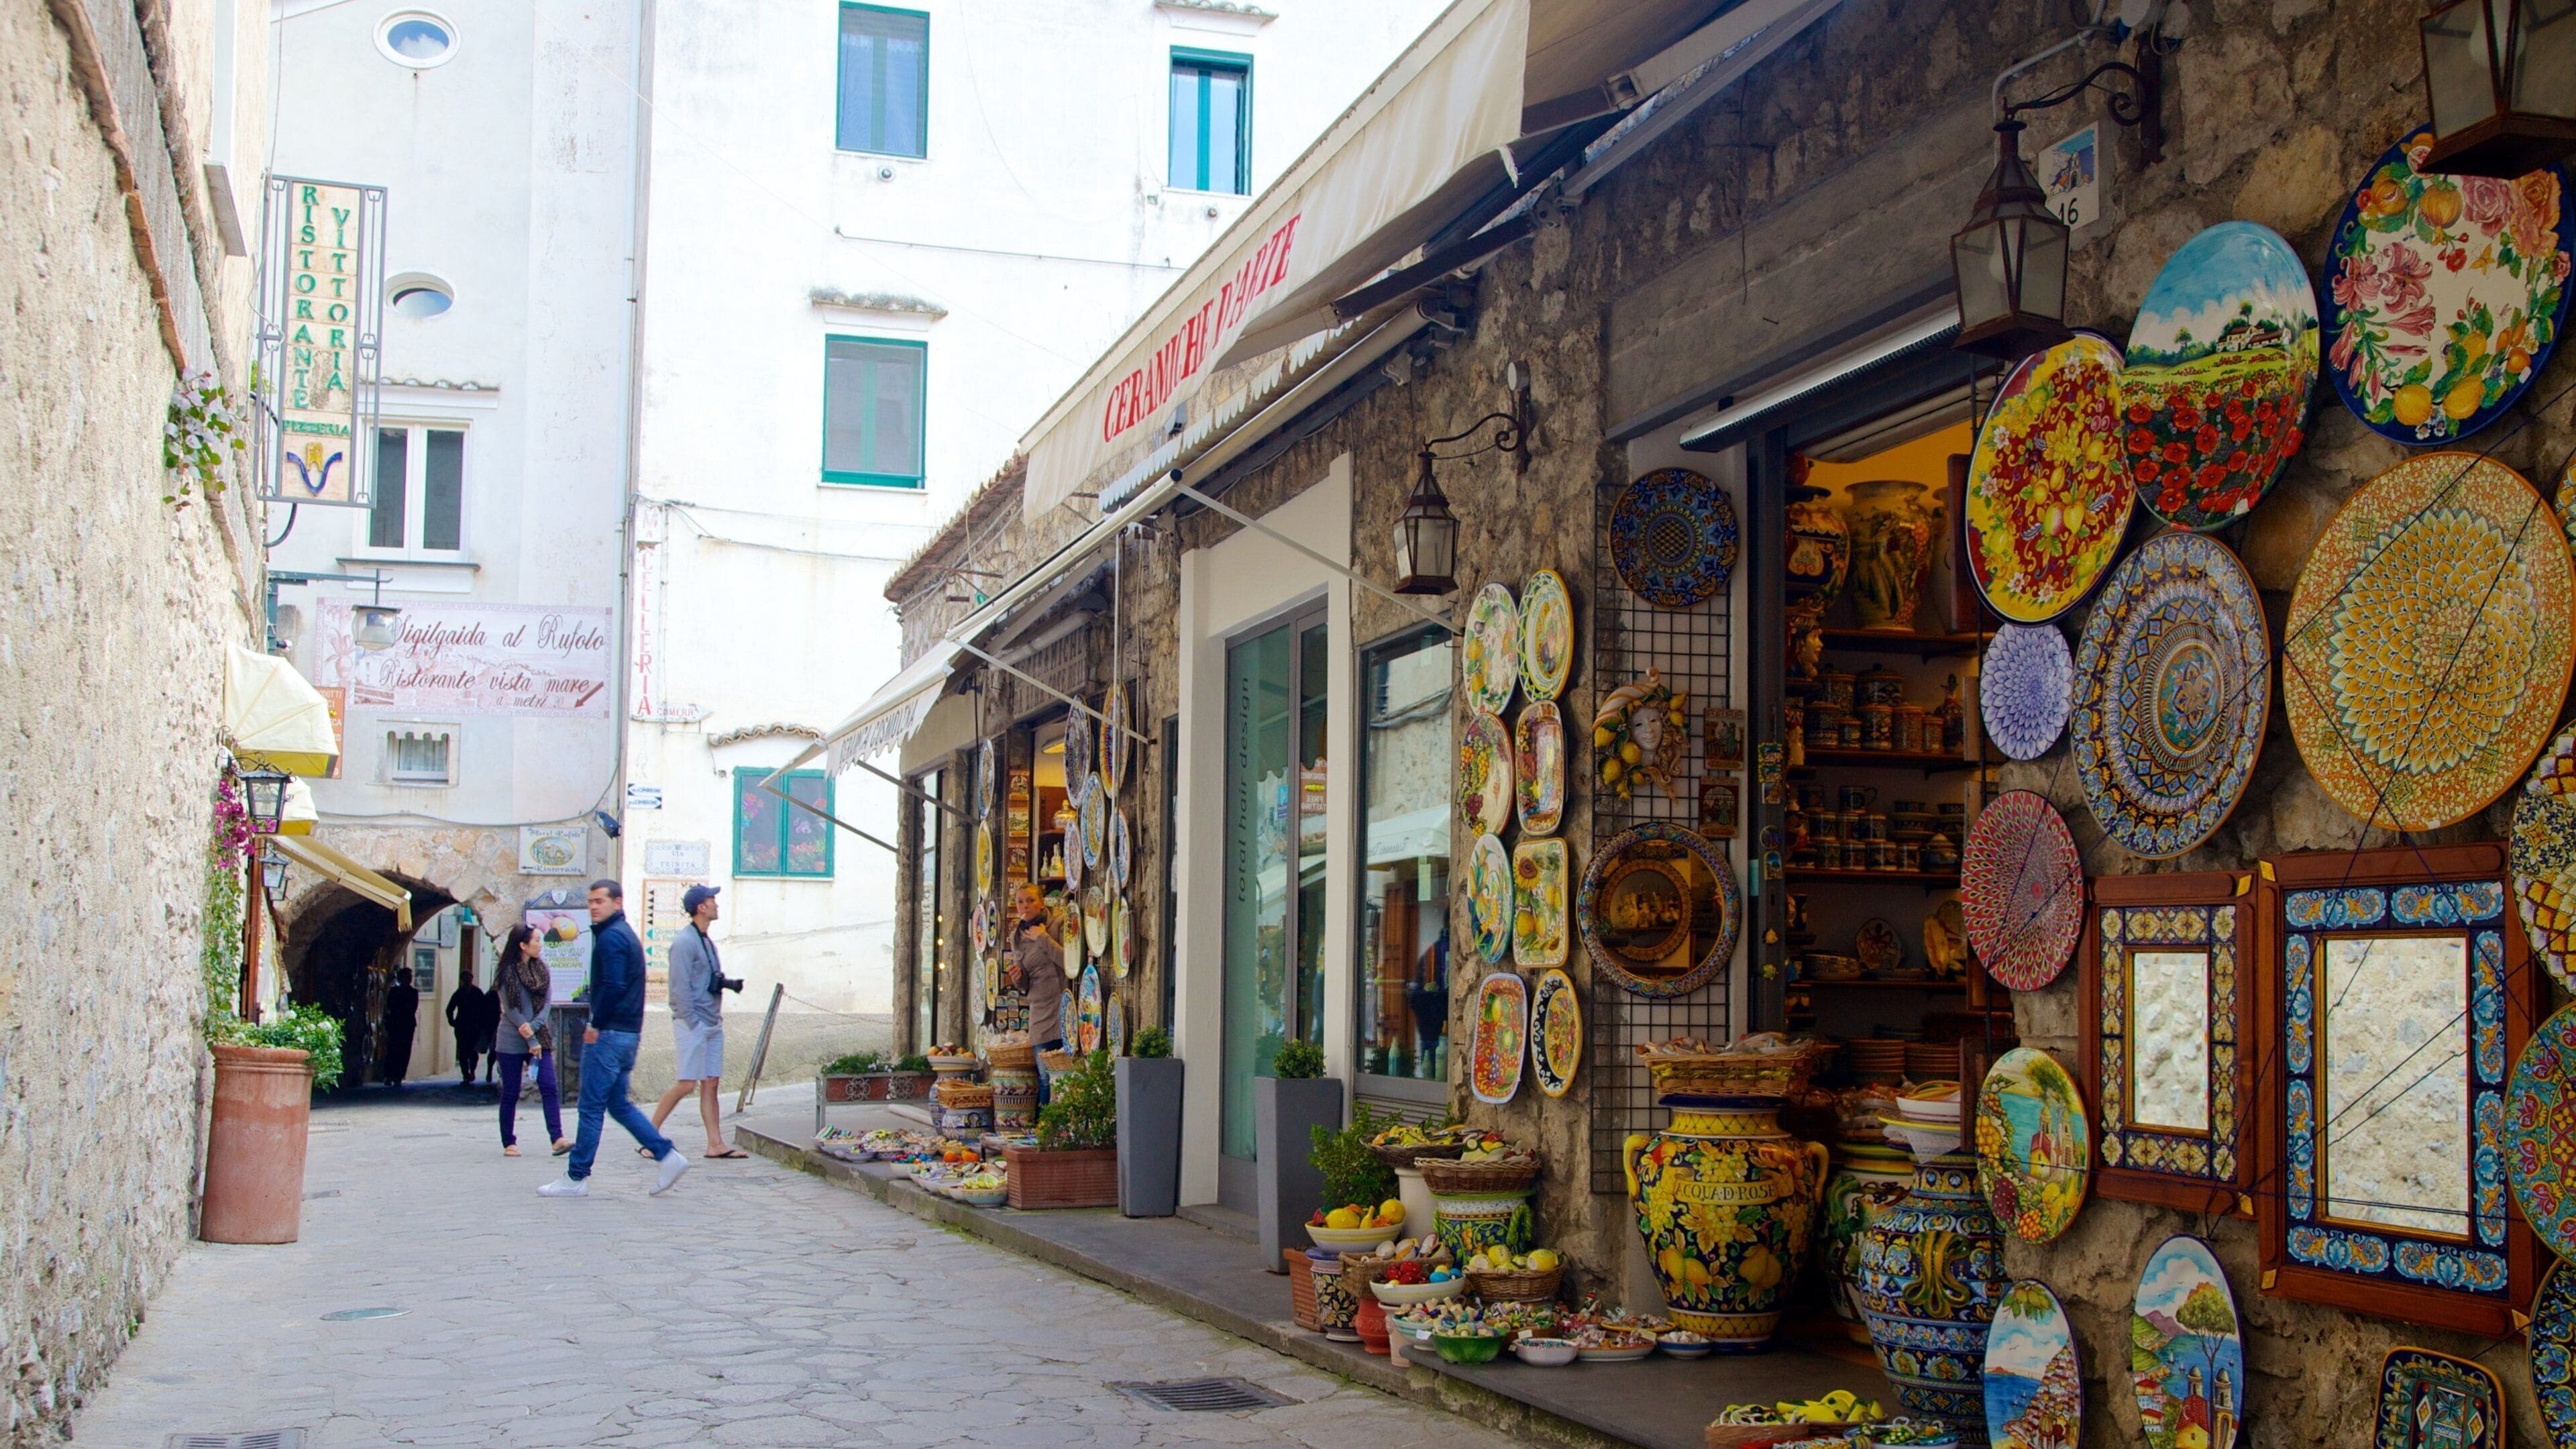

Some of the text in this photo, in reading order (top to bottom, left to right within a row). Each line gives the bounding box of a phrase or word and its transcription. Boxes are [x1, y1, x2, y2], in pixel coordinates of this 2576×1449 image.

[2058, 197, 2078, 225] 16
[294, 184, 319, 409] RISTORANTE
[326, 207, 351, 392] VITTORIA
[1104, 212, 1301, 443] CERAMICHE D'ARTE
[283, 419, 351, 437] PIZZERIA
[502, 624, 527, 648] al
[537, 613, 605, 658] Rufolo
[379, 658, 590, 694] Ristorante vista mare
[496, 696, 504, 706] a
[513, 694, 549, 708] metri
[1238, 678, 1250, 903] total hair design
